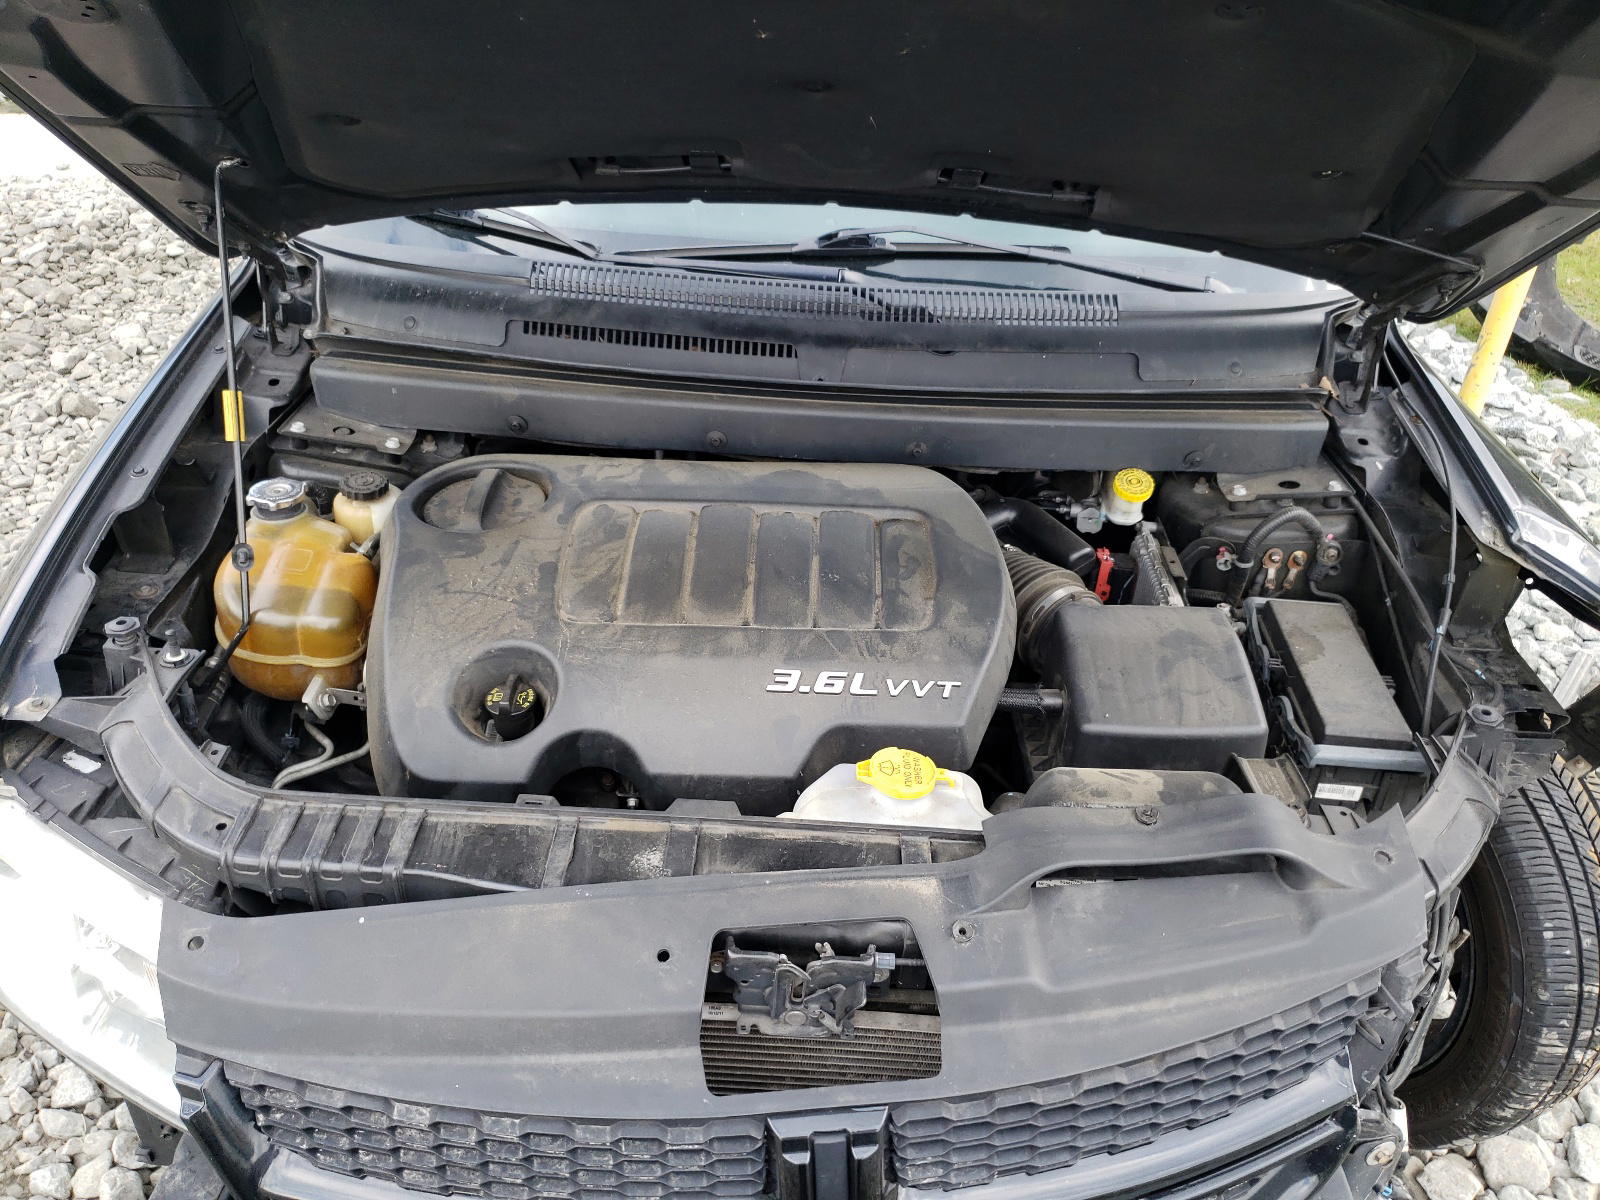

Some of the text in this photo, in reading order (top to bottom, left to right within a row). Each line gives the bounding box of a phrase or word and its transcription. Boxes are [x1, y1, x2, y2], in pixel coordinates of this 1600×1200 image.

[766, 669, 962, 698] 3.6L VVT
[902, 752, 913, 788] FLUID ONLY
[913, 757, 923, 785] WASHER
